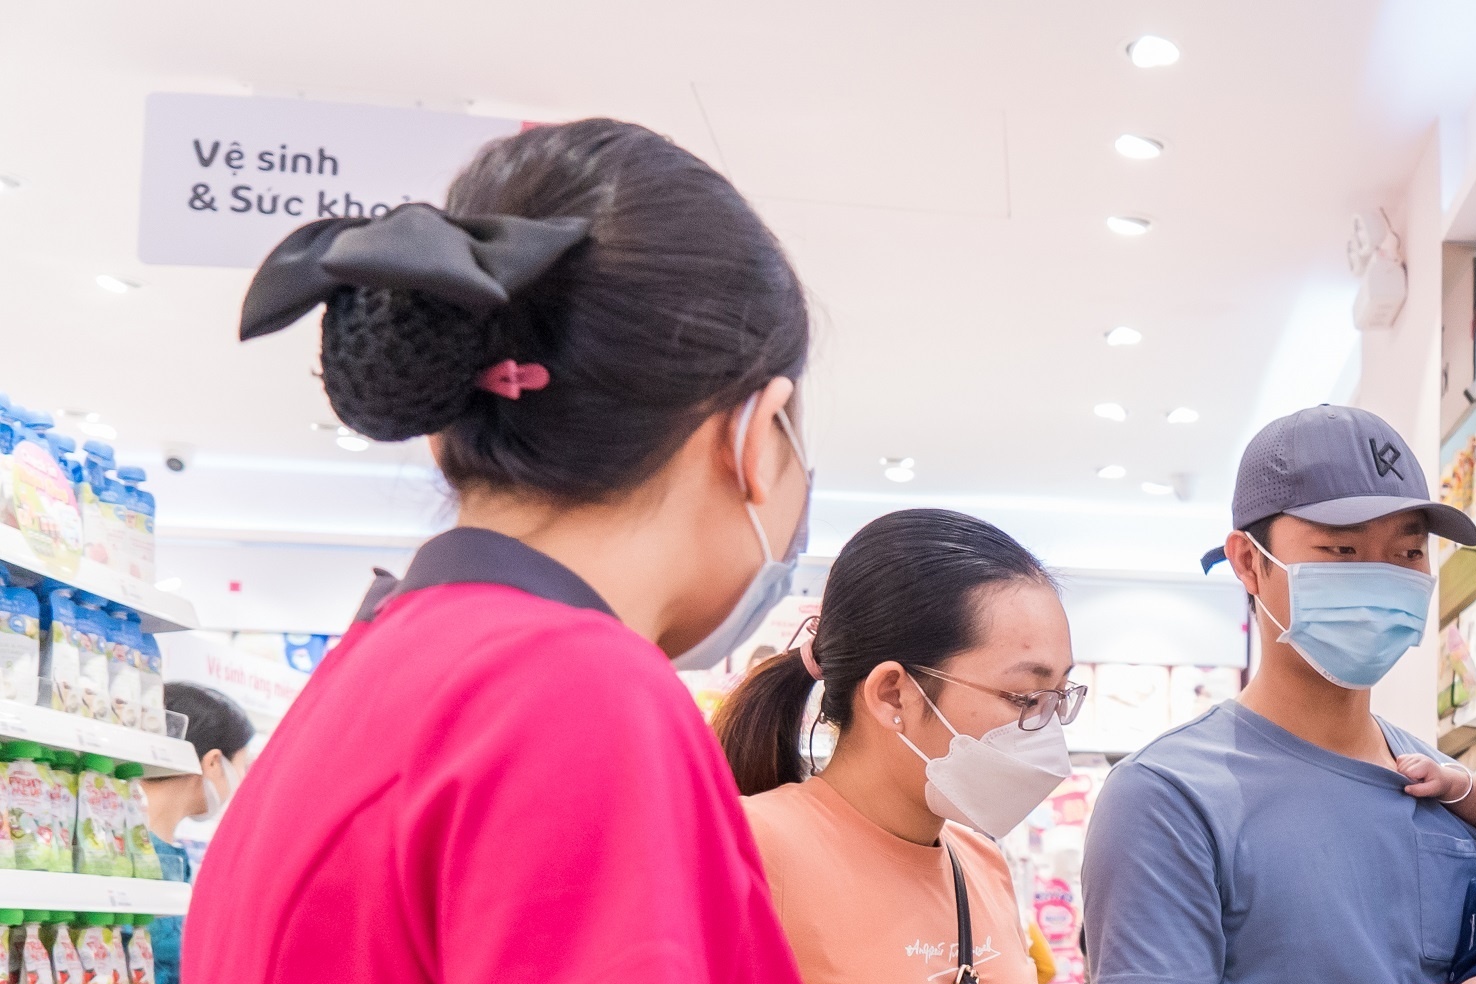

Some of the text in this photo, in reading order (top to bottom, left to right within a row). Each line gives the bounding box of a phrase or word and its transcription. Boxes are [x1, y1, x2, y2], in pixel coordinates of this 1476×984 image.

[193, 138, 339, 176] Vệ sinh
[188, 183, 218, 212] &
